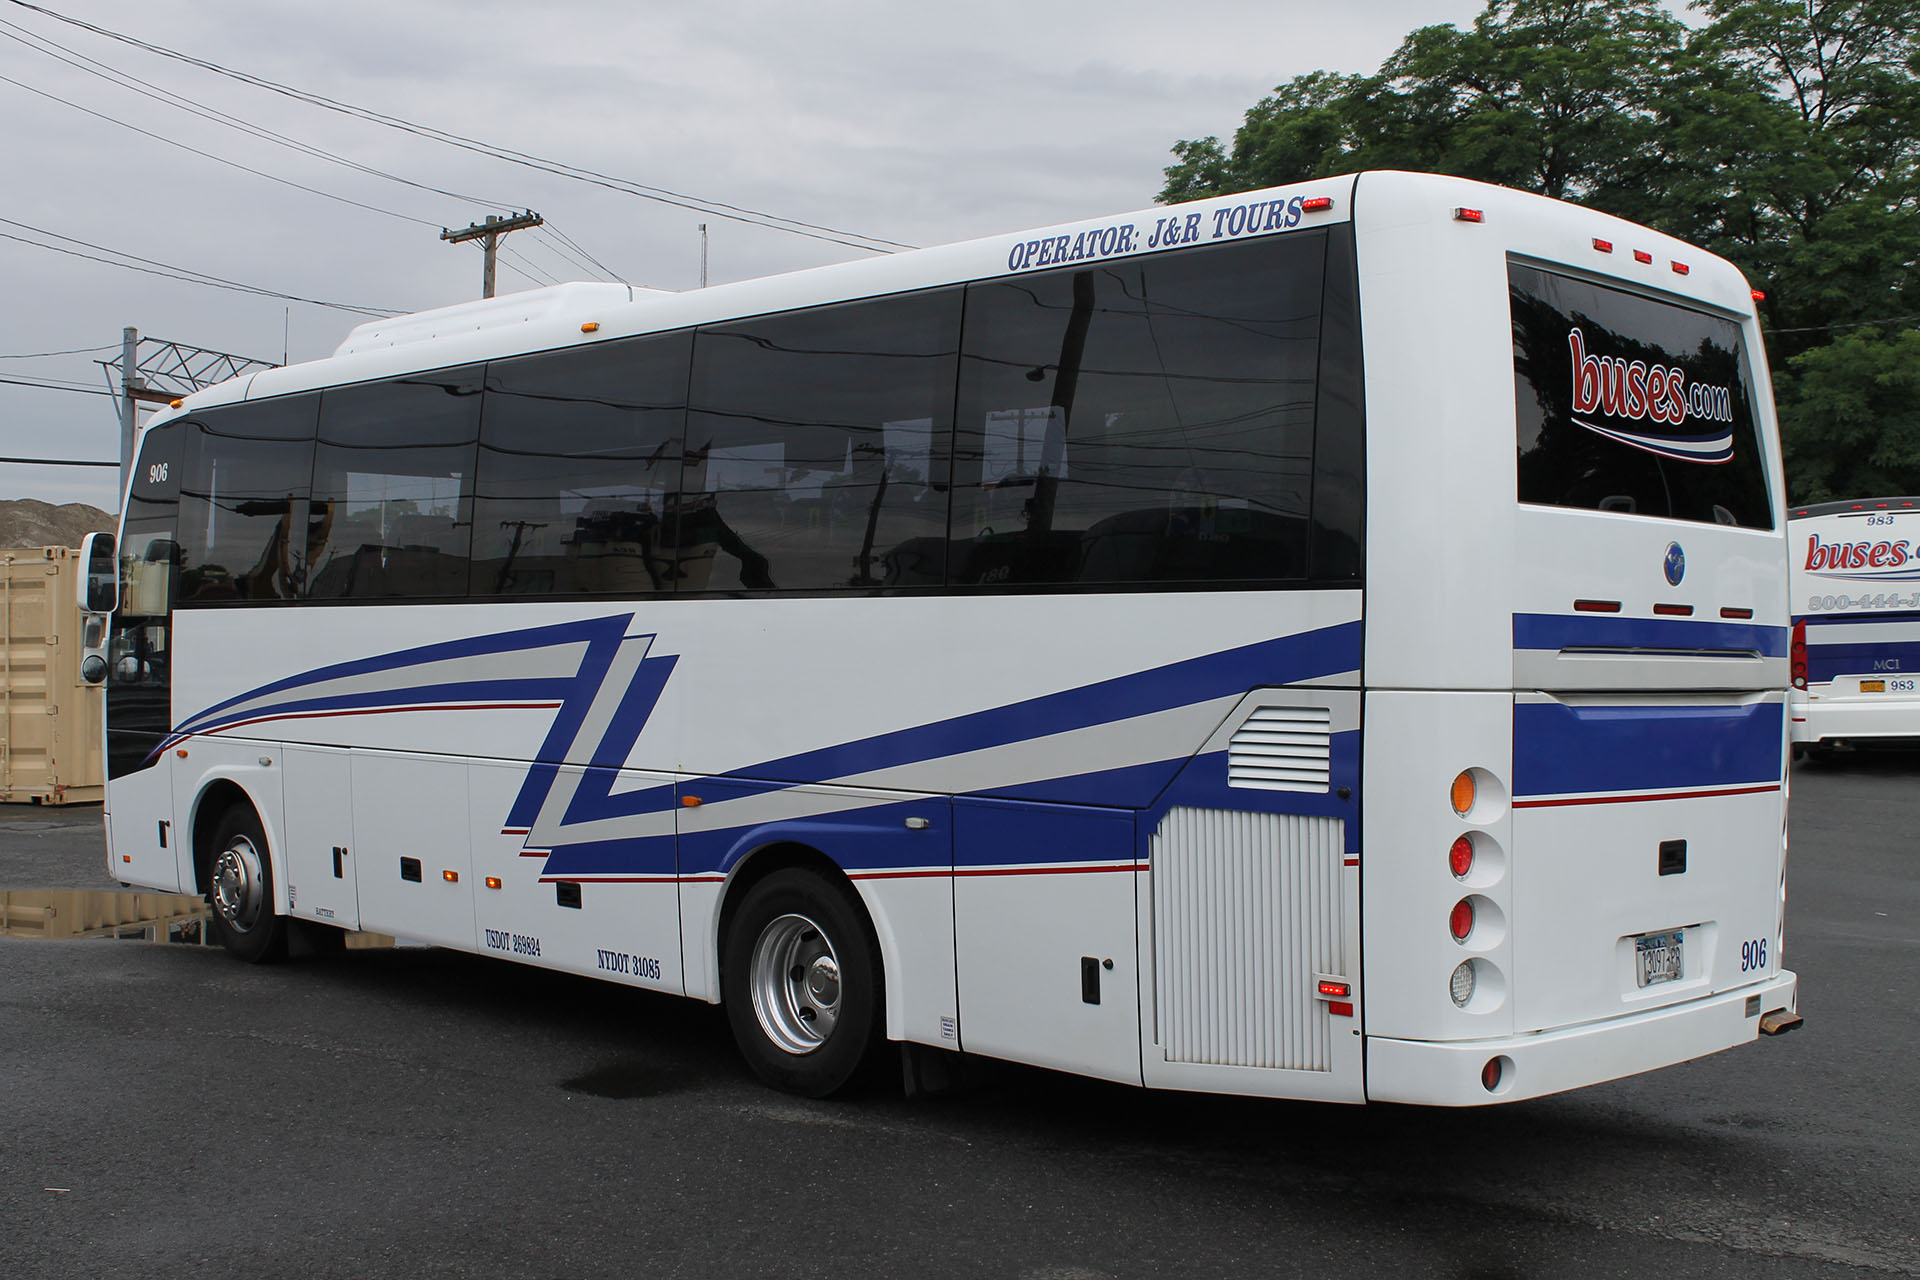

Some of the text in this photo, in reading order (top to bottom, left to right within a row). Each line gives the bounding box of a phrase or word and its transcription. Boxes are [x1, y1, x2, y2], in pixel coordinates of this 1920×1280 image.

[1008, 195, 1305, 271] OPERATOR: J&R TOURS
[1568, 327, 1733, 425] buses.com
[149, 462, 168, 484] 906
[1867, 515, 1894, 526] 983
[1804, 533, 1920, 571] buses.
[1873, 659, 1901, 671] MCI
[1890, 680, 1914, 691] 983
[485, 929, 541, 957] USDOT 269824
[1741, 938, 1767, 973] 906
[597, 949, 661, 980] NYDOT 31085
